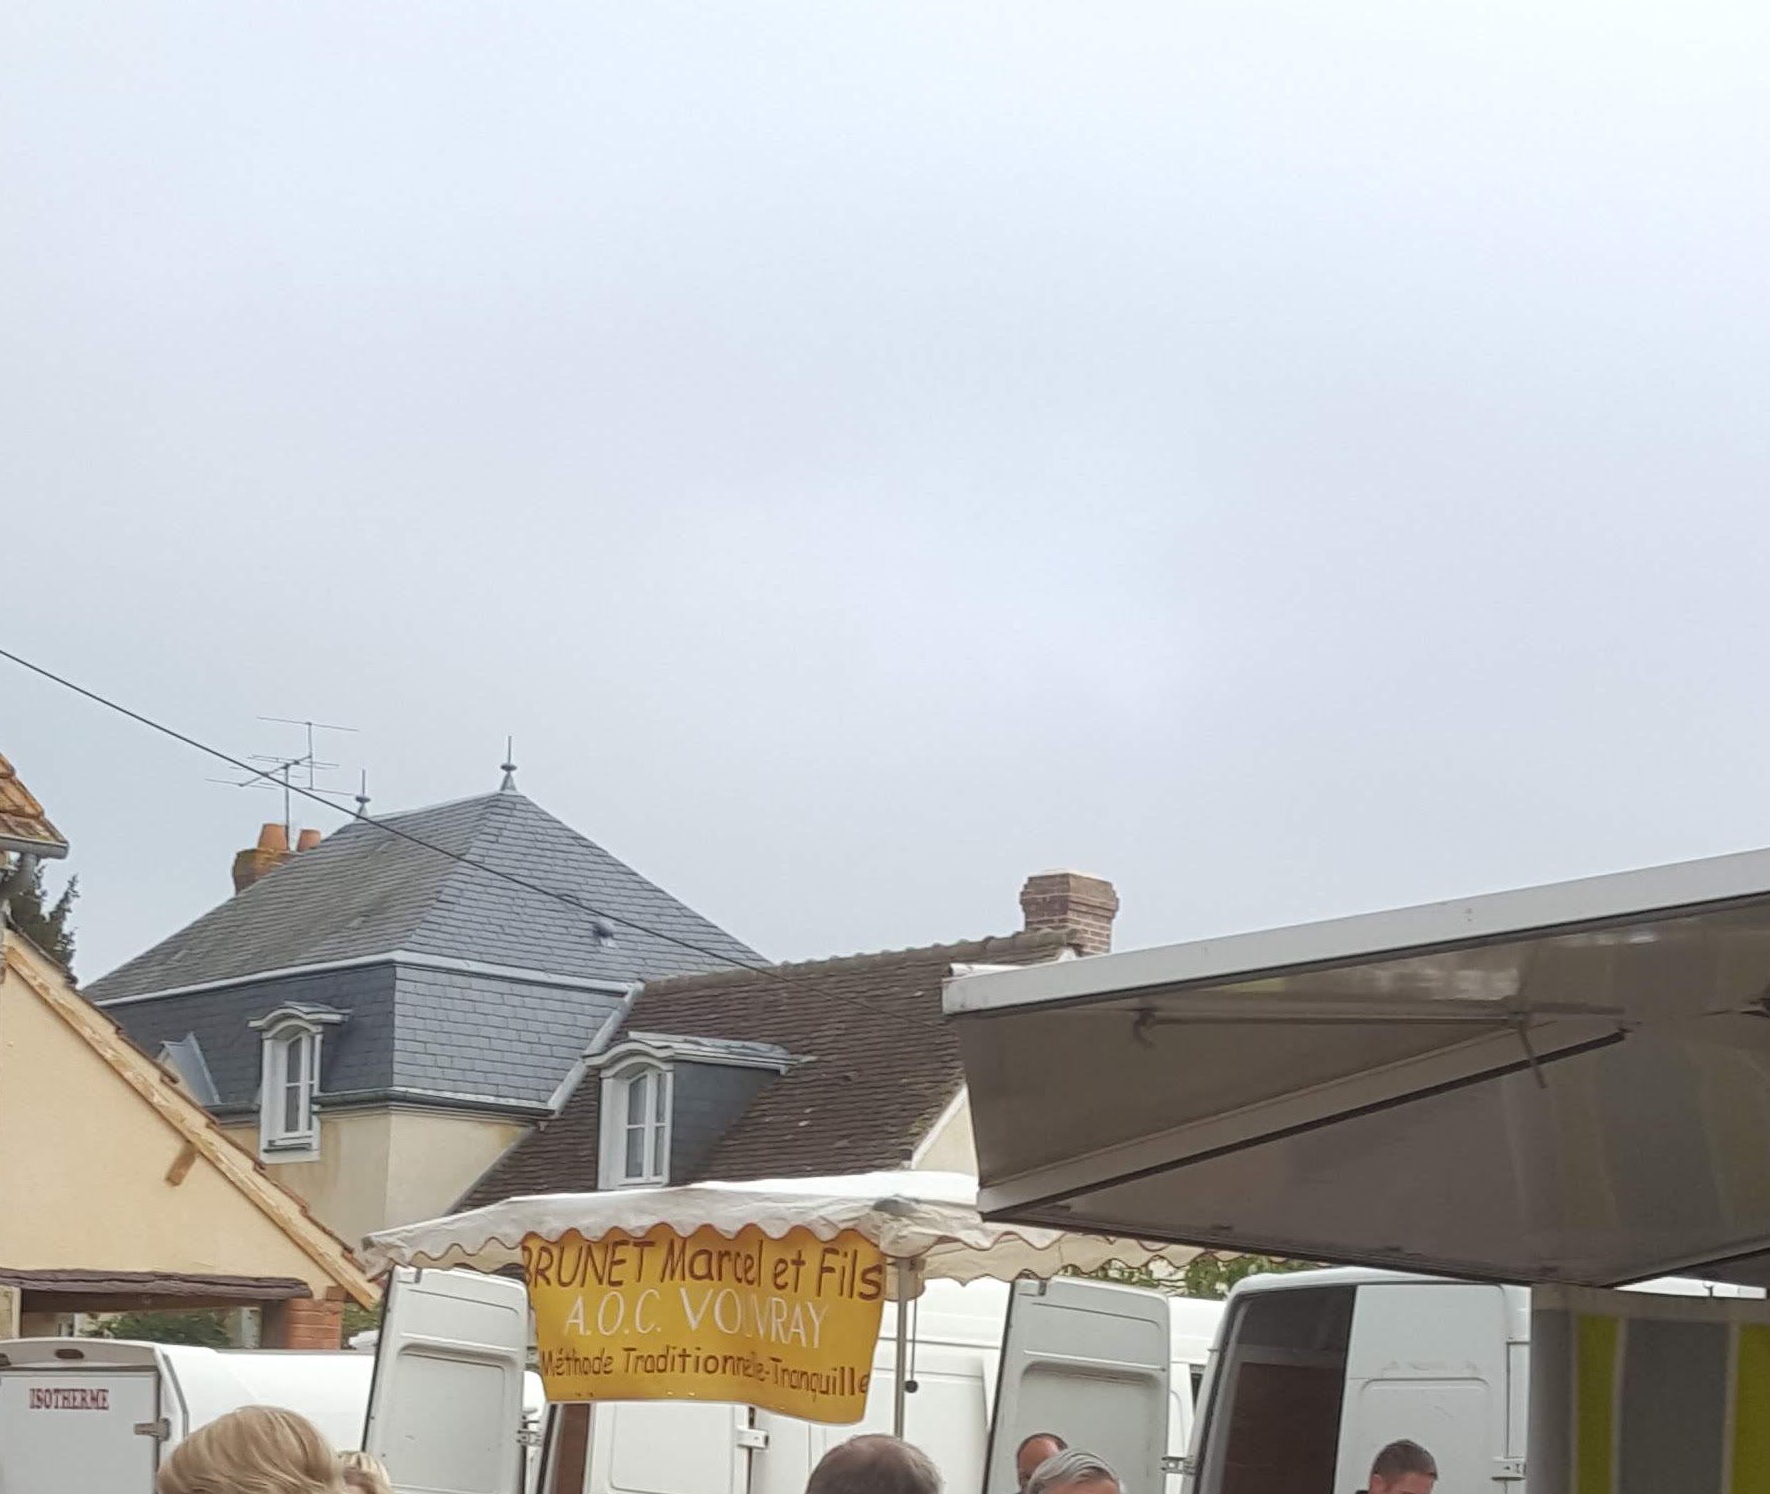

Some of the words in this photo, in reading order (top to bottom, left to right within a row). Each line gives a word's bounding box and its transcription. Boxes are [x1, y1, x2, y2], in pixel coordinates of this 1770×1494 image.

[521, 1239, 656, 1288] BRUNET
[660, 1238, 764, 1287] Marcel
[773, 1250, 806, 1293] et
[816, 1247, 884, 1301] Fils
[541, 1346, 614, 1377] Méthode
[29, 1387, 110, 1410] ISOTHERME
